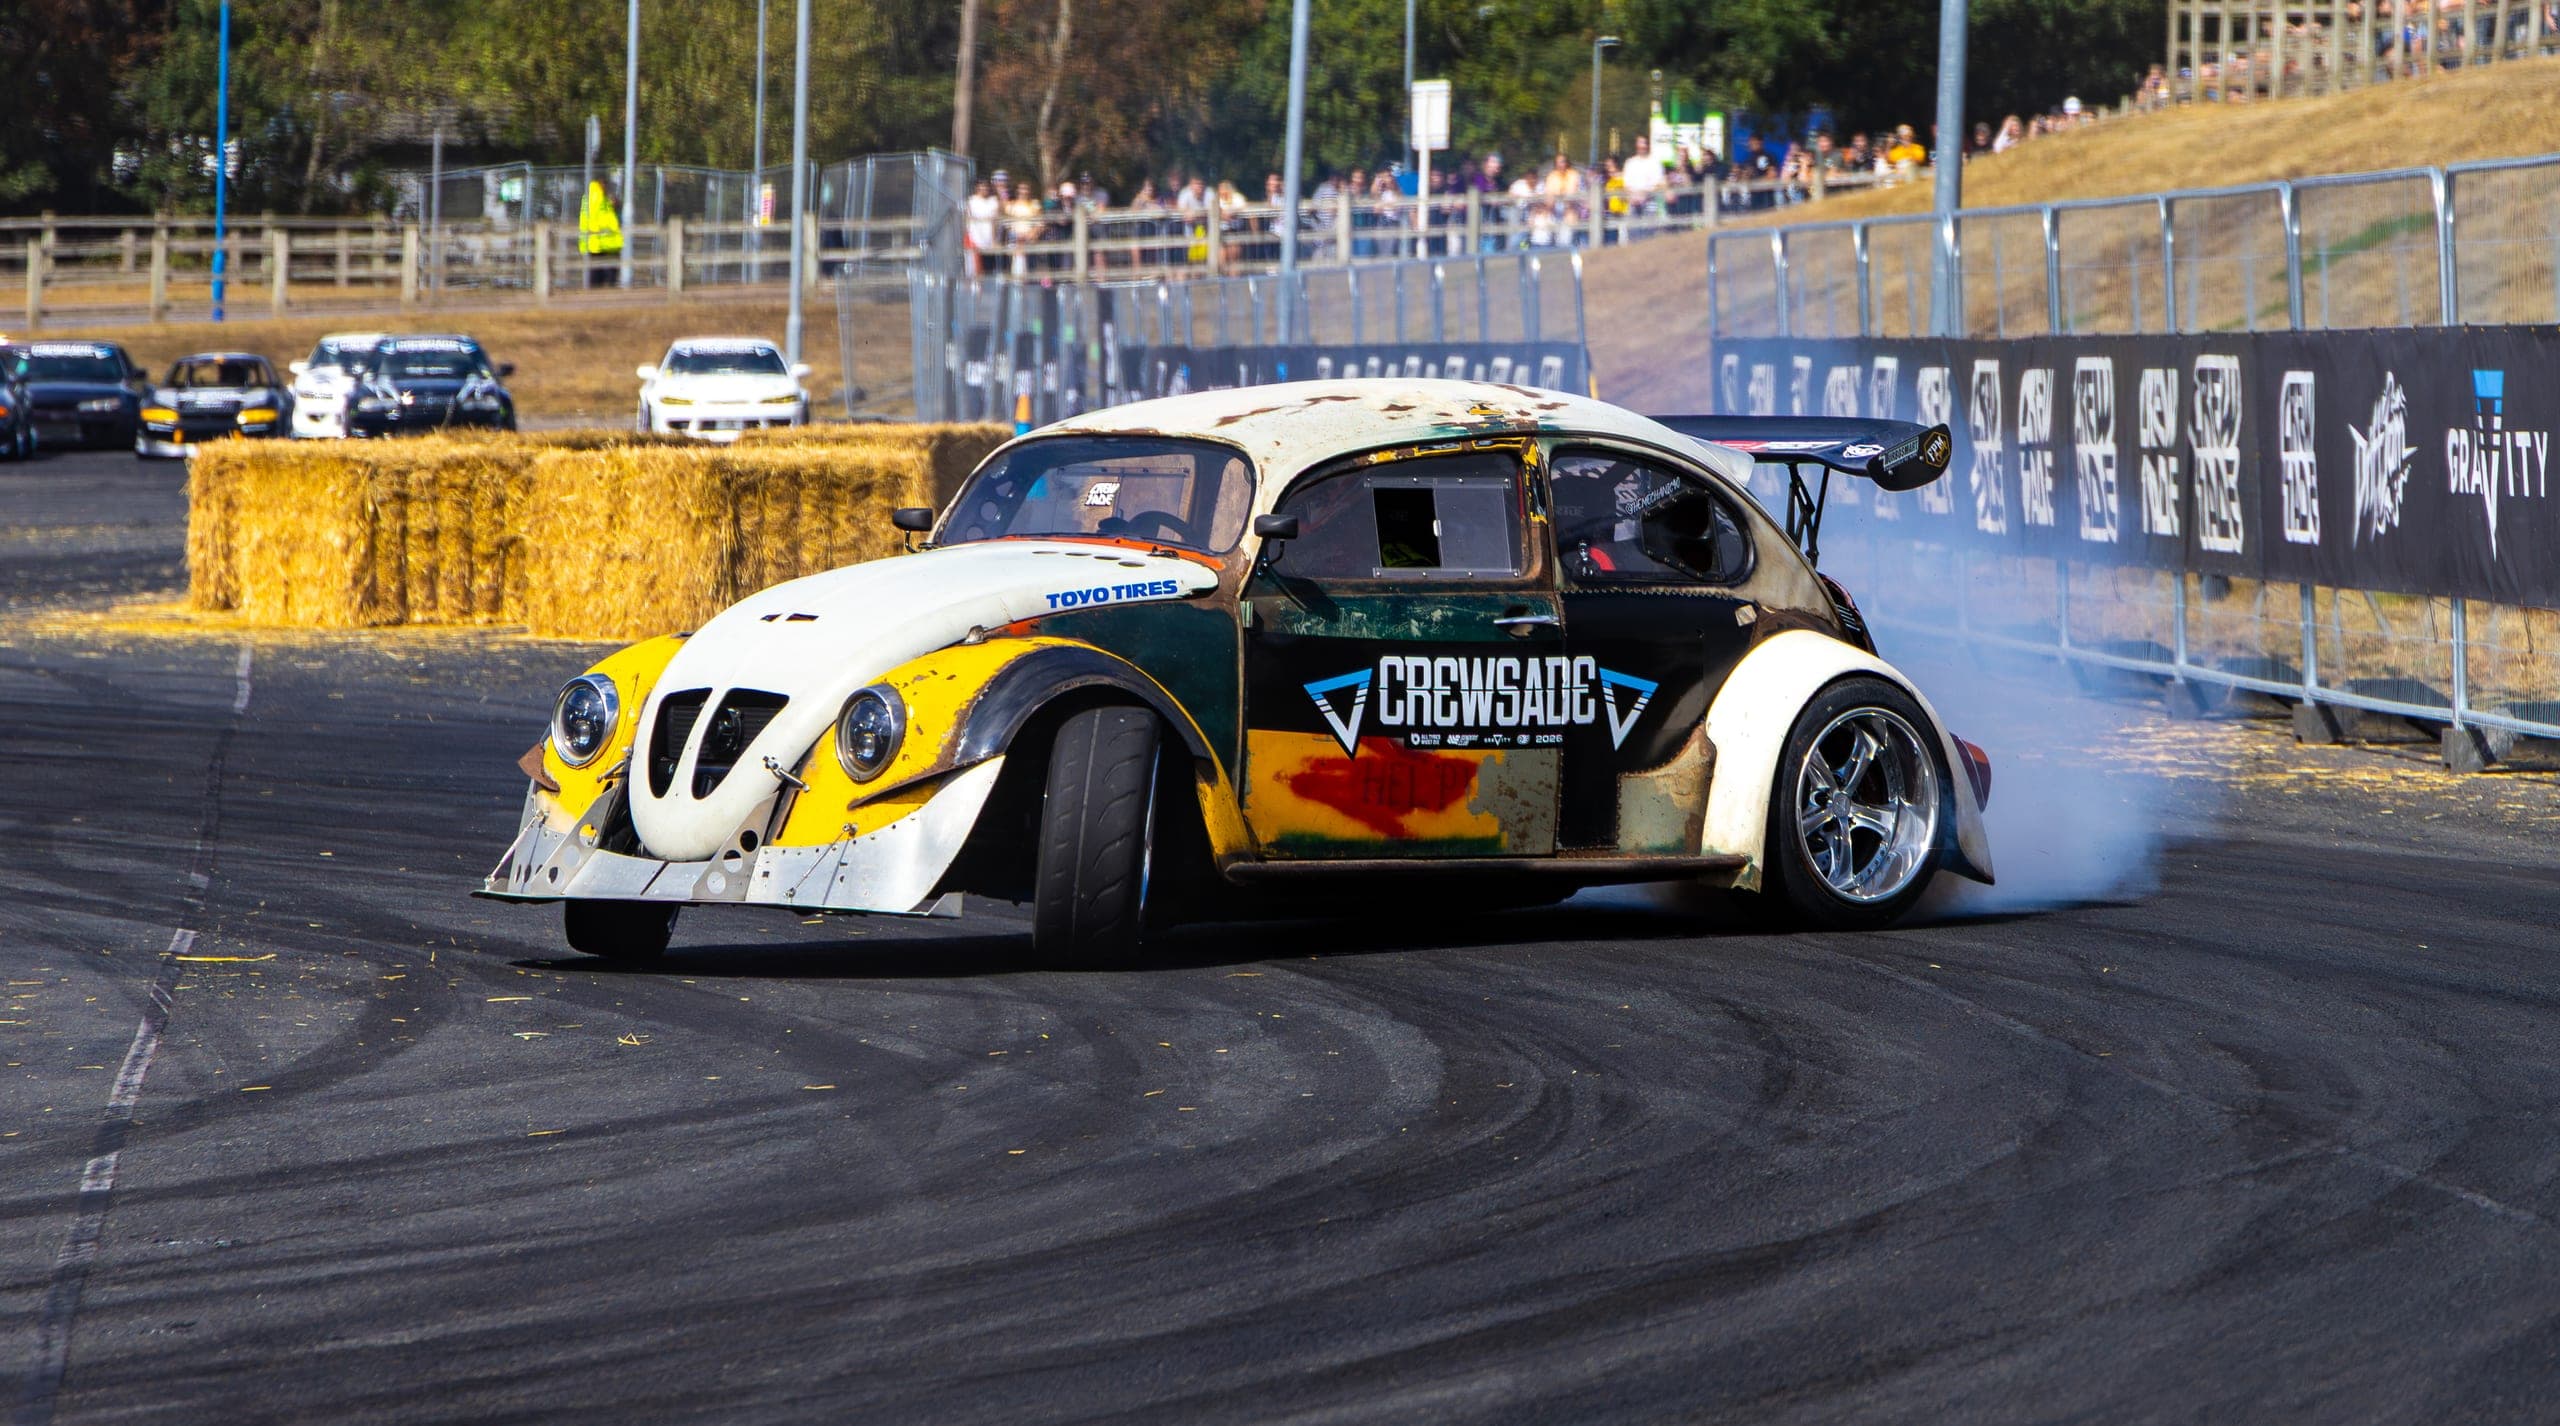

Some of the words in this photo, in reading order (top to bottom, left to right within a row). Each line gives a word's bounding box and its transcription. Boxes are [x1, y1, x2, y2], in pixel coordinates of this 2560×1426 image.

[1046, 587, 1109, 609] TOYO
[1111, 580, 1178, 600] TIRES
[1379, 656, 1596, 727] CREWSADE
[1535, 734, 1563, 744] 2026
